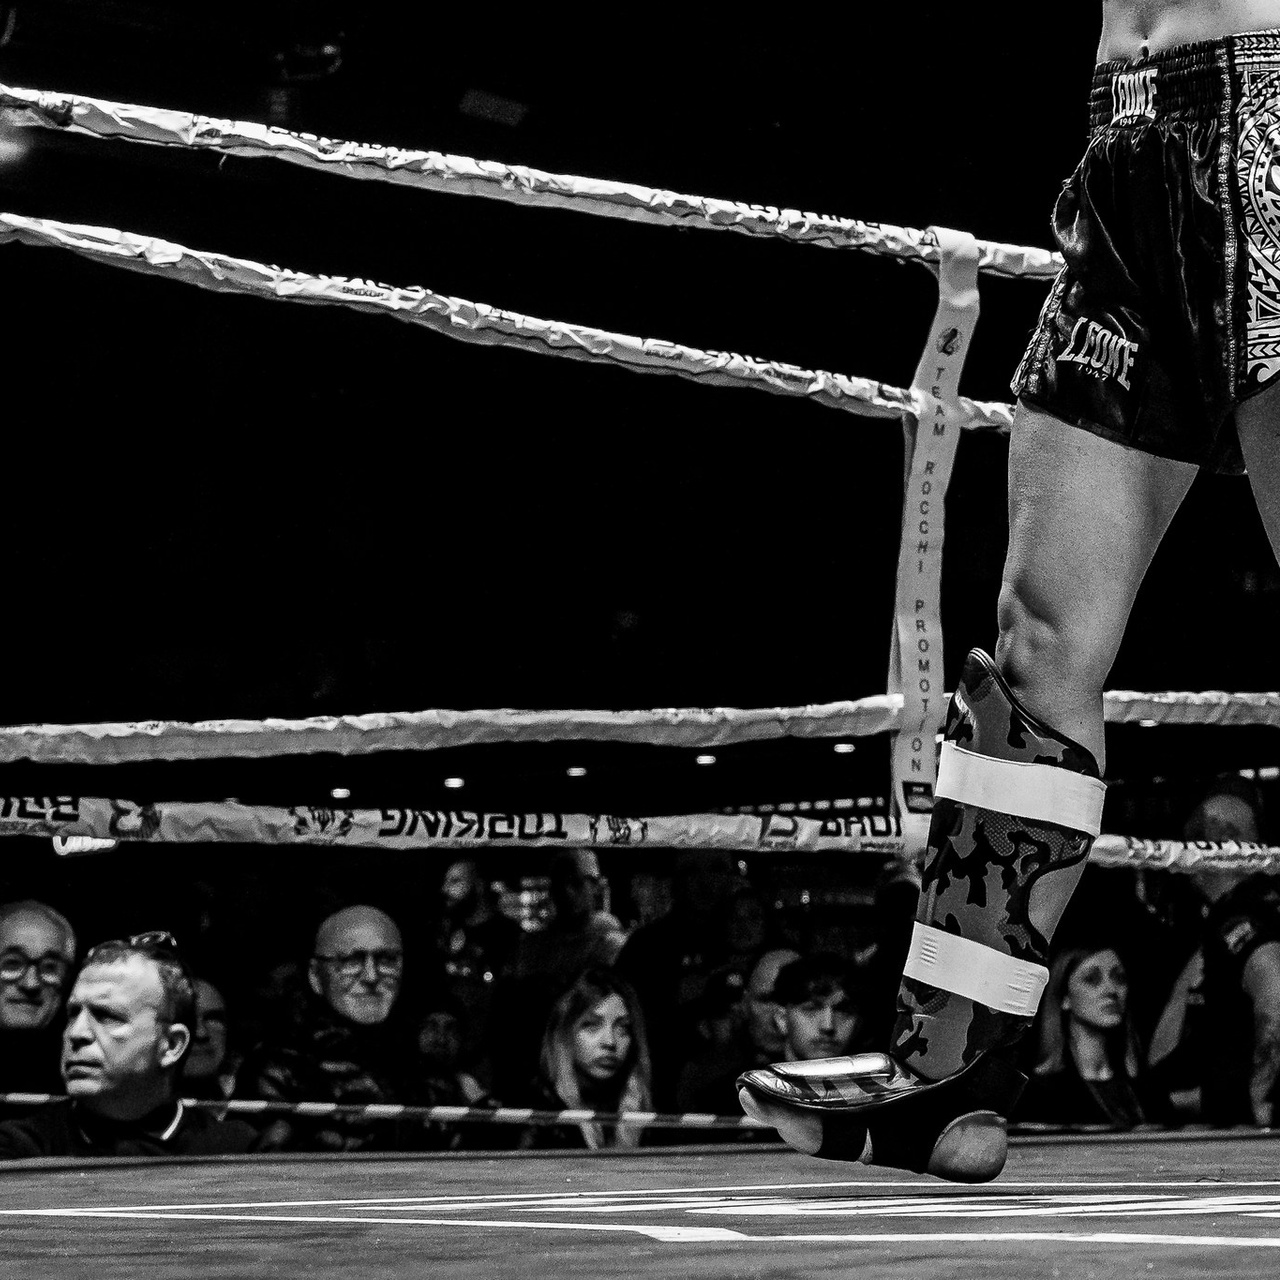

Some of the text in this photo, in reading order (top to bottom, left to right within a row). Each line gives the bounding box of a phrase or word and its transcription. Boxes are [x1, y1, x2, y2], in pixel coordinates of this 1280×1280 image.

[1110, 69, 1158, 126] LEONE
[1056, 316, 1139, 391] LEONE
[910, 367, 946, 772] TEAM ROCCHI PROMOTION
